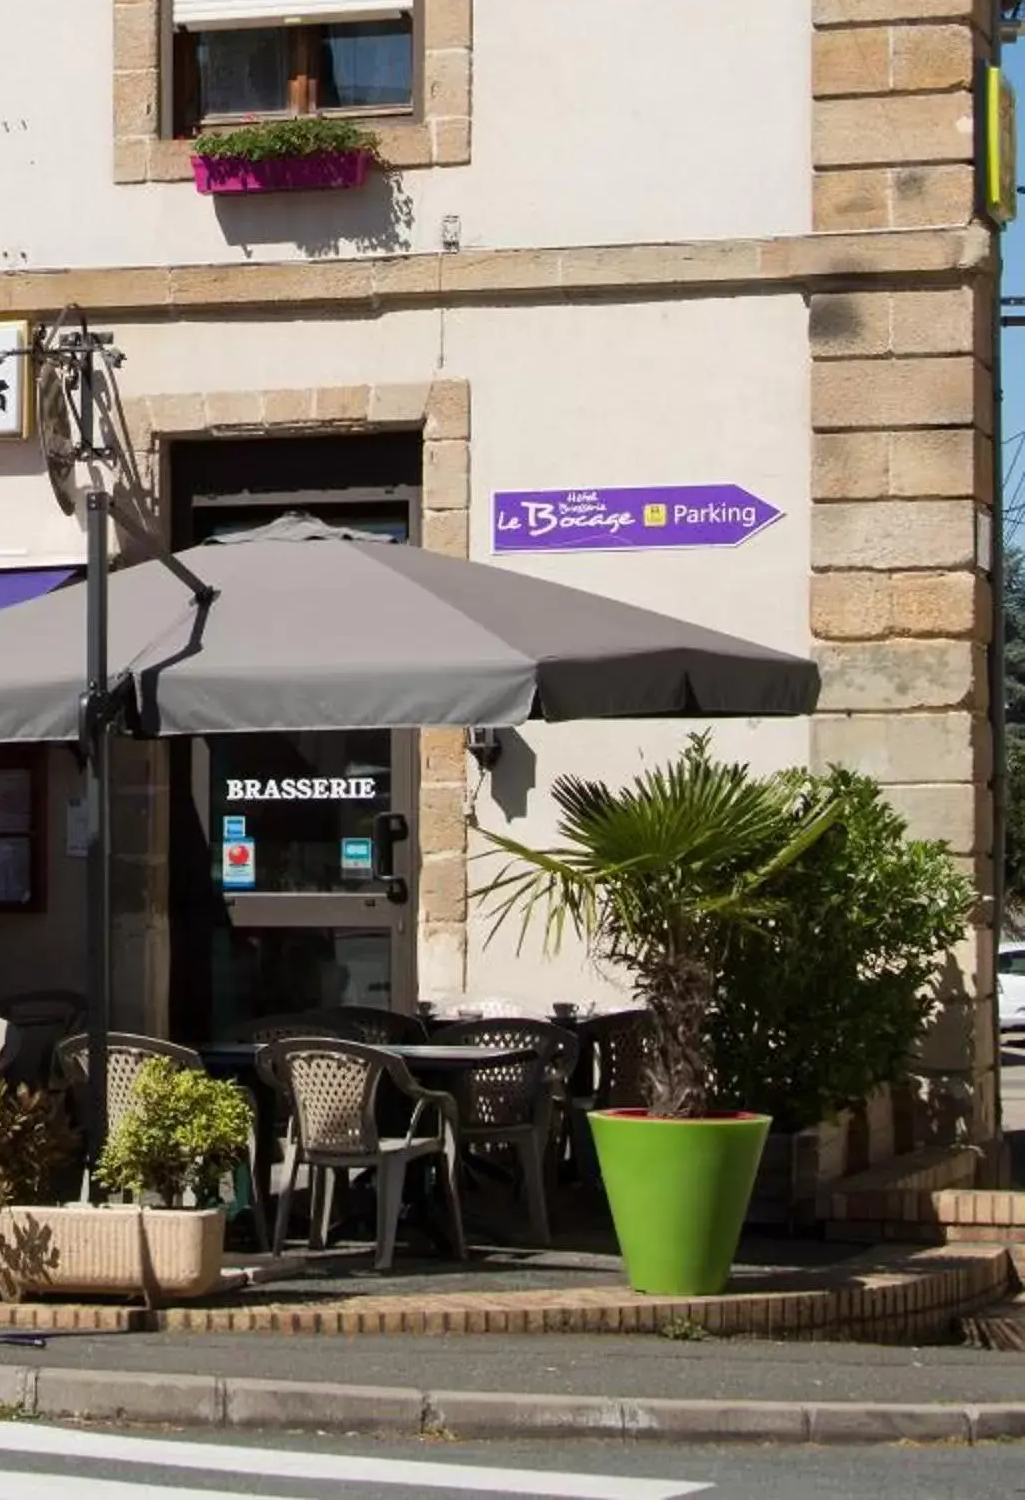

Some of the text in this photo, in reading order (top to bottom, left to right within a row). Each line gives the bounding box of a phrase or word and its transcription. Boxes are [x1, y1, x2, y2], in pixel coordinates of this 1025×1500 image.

[497, 501, 636, 537] Le Bocage
[674, 504, 756, 527] Parking
[226, 777, 376, 800] BRASSERIE
